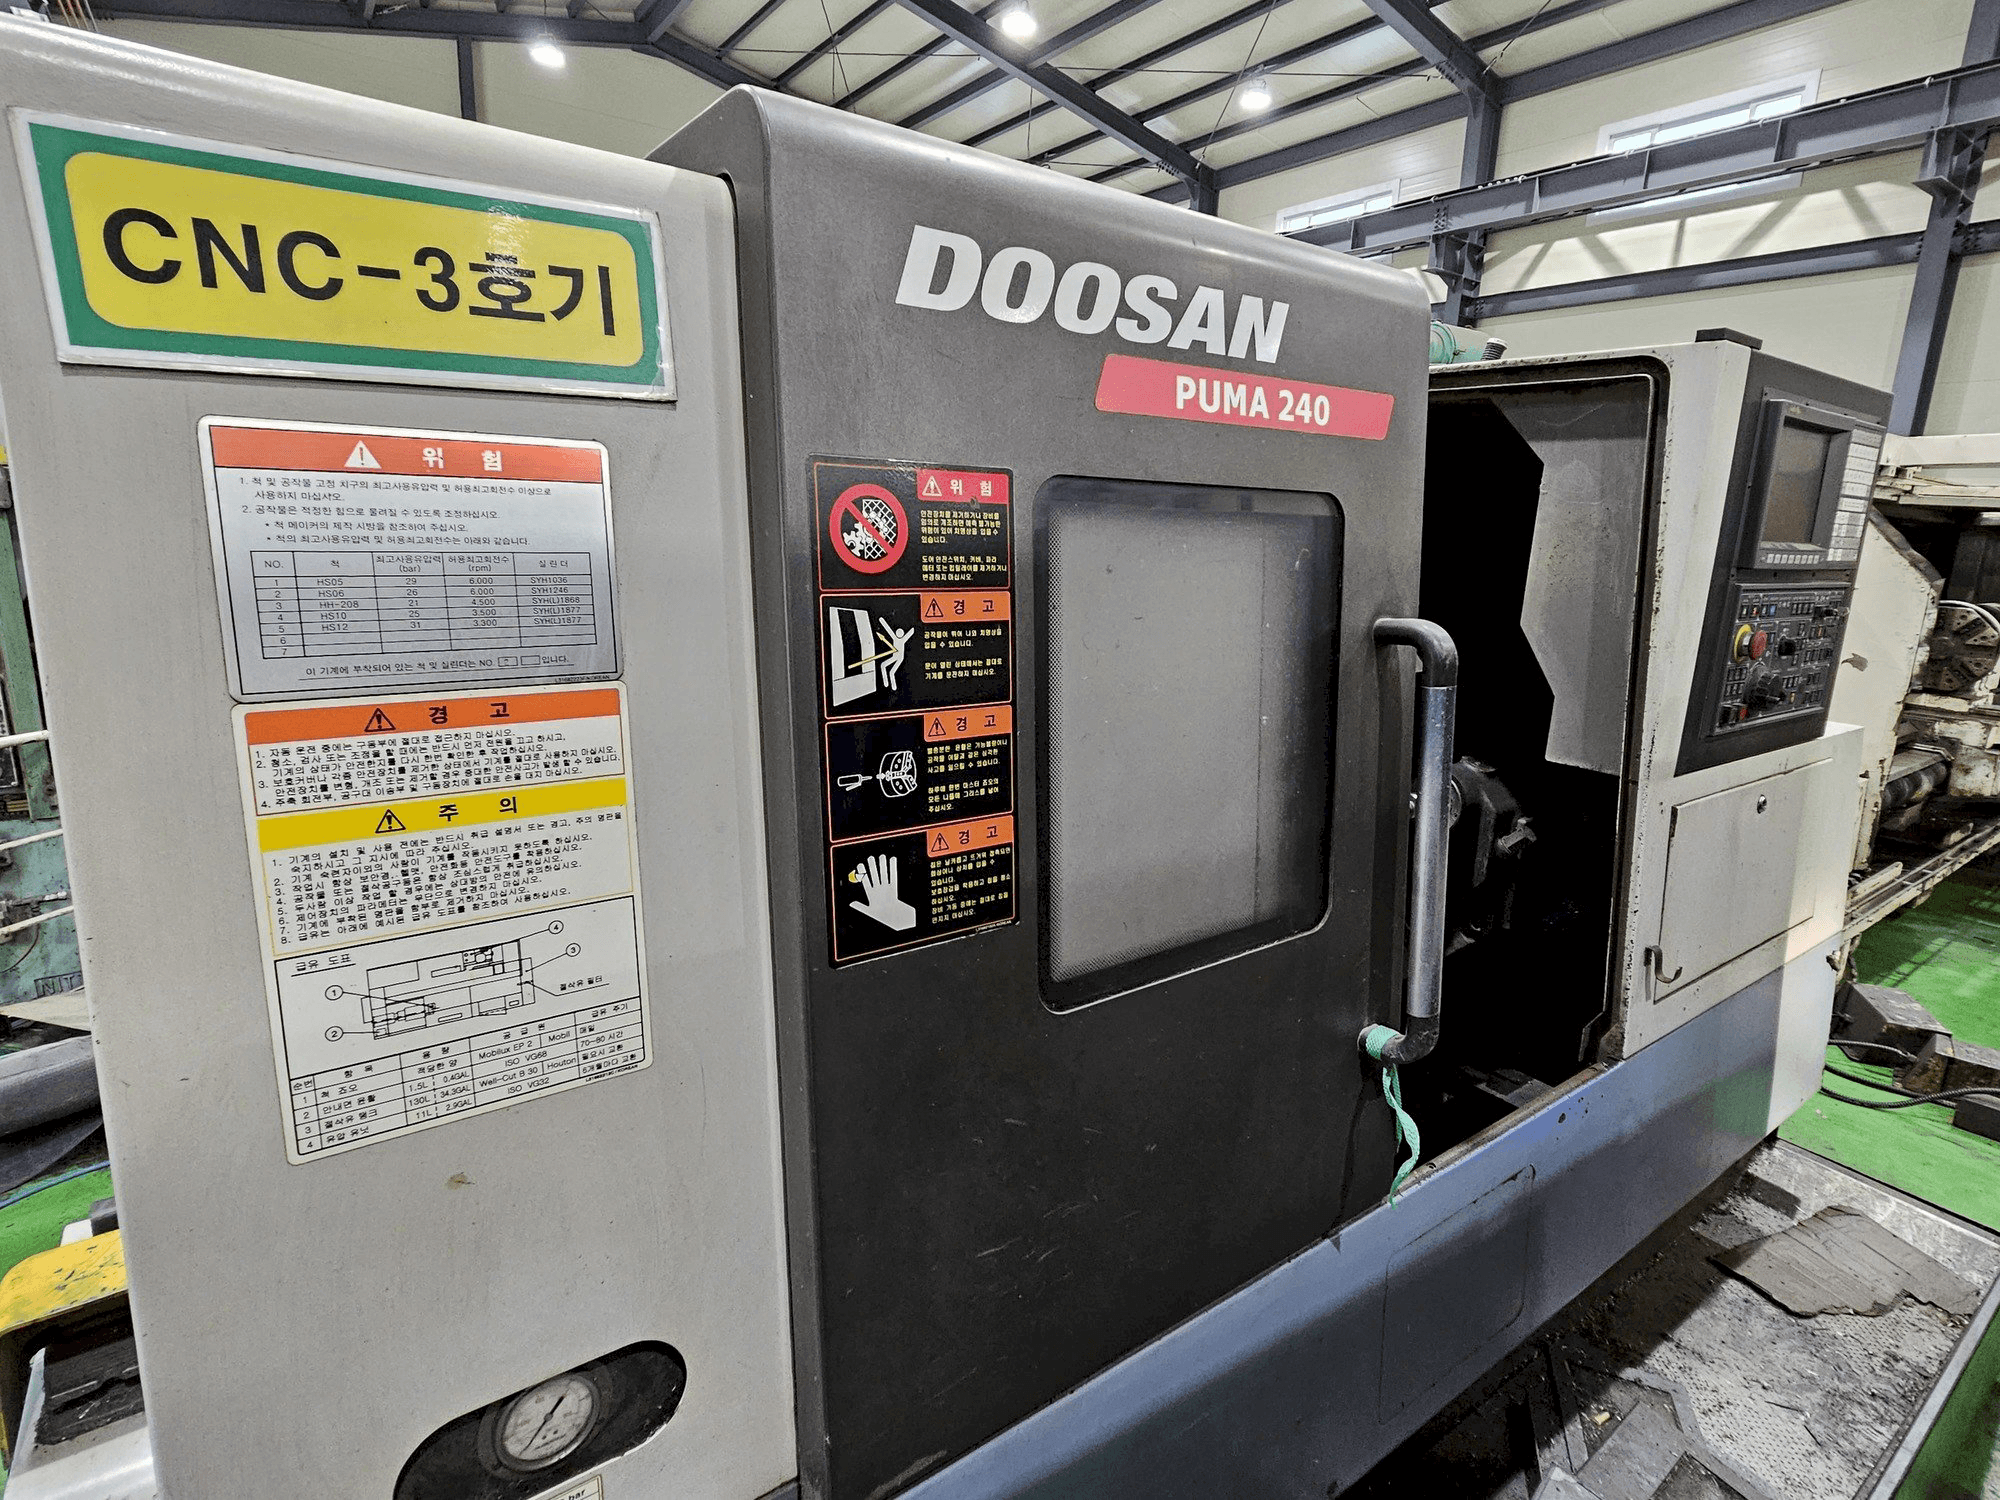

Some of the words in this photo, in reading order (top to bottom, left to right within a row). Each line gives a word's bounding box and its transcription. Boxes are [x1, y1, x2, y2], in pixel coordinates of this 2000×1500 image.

[102, 207, 617, 337] CNC-3호기
[895, 225, 1289, 364] DOOSAN
[1175, 375, 1270, 419] PUMA
[1277, 389, 1331, 427] 240
[251, 476, 262, 486] 척
[266, 477, 276, 486] 및
[280, 477, 311, 487] 공작물
[315, 478, 335, 488] 고정
[339, 479, 368, 489] 치구의
[372, 480, 438, 491] 최고사용유압력
[441, 483, 450, 492] 및
[454, 484, 515, 494] 허용최고회전수
[517, 486, 551, 496] 이상으로
[254, 490, 297, 500] 사용하지
[300, 491, 344, 501] 마십시오.
[241, 504, 252, 513] 2.
[254, 504, 297, 515] 공작물은
[301, 506, 332, 516] 적정한
[335, 506, 365, 516] 힘으로
[400, 508, 410, 517] 수
[412, 508, 441, 518] 있도록
[444, 509, 500, 519] 조정하십시오.
[273, 520, 284, 529] 척
[287, 520, 329, 530] 메이커의
[332, 521, 353, 530] 제작
[355, 521, 385, 531] 시방을
[388, 522, 426, 531] 참조하여
[430, 523, 471, 532] 주십시오.
[275, 534, 296, 543] 척의
[300, 534, 370, 544] 최고사용유압력
[373, 535, 383, 544] 및
[386, 535, 461, 545] 허용최고회전수는
[463, 536, 490, 545] 아래와
[493, 536, 533, 545] 같습니다.
[264, 559, 283, 568] NO.
[330, 559, 340, 568] 척
[375, 554, 441, 564] 최고사용유압력
[447, 554, 509, 564] 허용최고회전수
[398, 564, 421, 573] (bar)
[468, 563, 492, 572] (rpm)
[316, 577, 343, 586] HS05
[404, 577, 417, 585] 29
[529, 576, 568, 584] SYH1036
[274, 590, 281, 598] 2
[317, 589, 345, 597] HS06
[405, 588, 418, 596] 26
[530, 586, 568, 594] SYH1246
[319, 600, 359, 608] HH-208
[407, 599, 418, 607] 21
[531, 596, 580, 604] SYH(L)1868
[275, 601, 282, 610] 3
[532, 606, 580, 614] SYH(L)1877
[277, 613, 283, 621] 4
[320, 611, 347, 620] HS10
[407, 609, 420, 618] 25
[409, 620, 421, 628] 31
[533, 616, 582, 624] SYH(L)1877
[278, 624, 285, 633] 5
[321, 622, 348, 631] HS12
[279, 636, 286, 644] 6
[280, 647, 287, 655] 7
[541, 654, 569, 664] 입니다.
[305, 667, 316, 676] 이
[319, 665, 349, 675] 기계에
[352, 663, 391, 674] 부착되어
[394, 662, 413, 672] 있는
[416, 661, 426, 670] 척
[428, 661, 437, 670] 및
[441, 659, 476, 669] 실린더는
[478, 1046, 511, 1059] Mobilux
[546, 1057, 576, 1070] Houton
